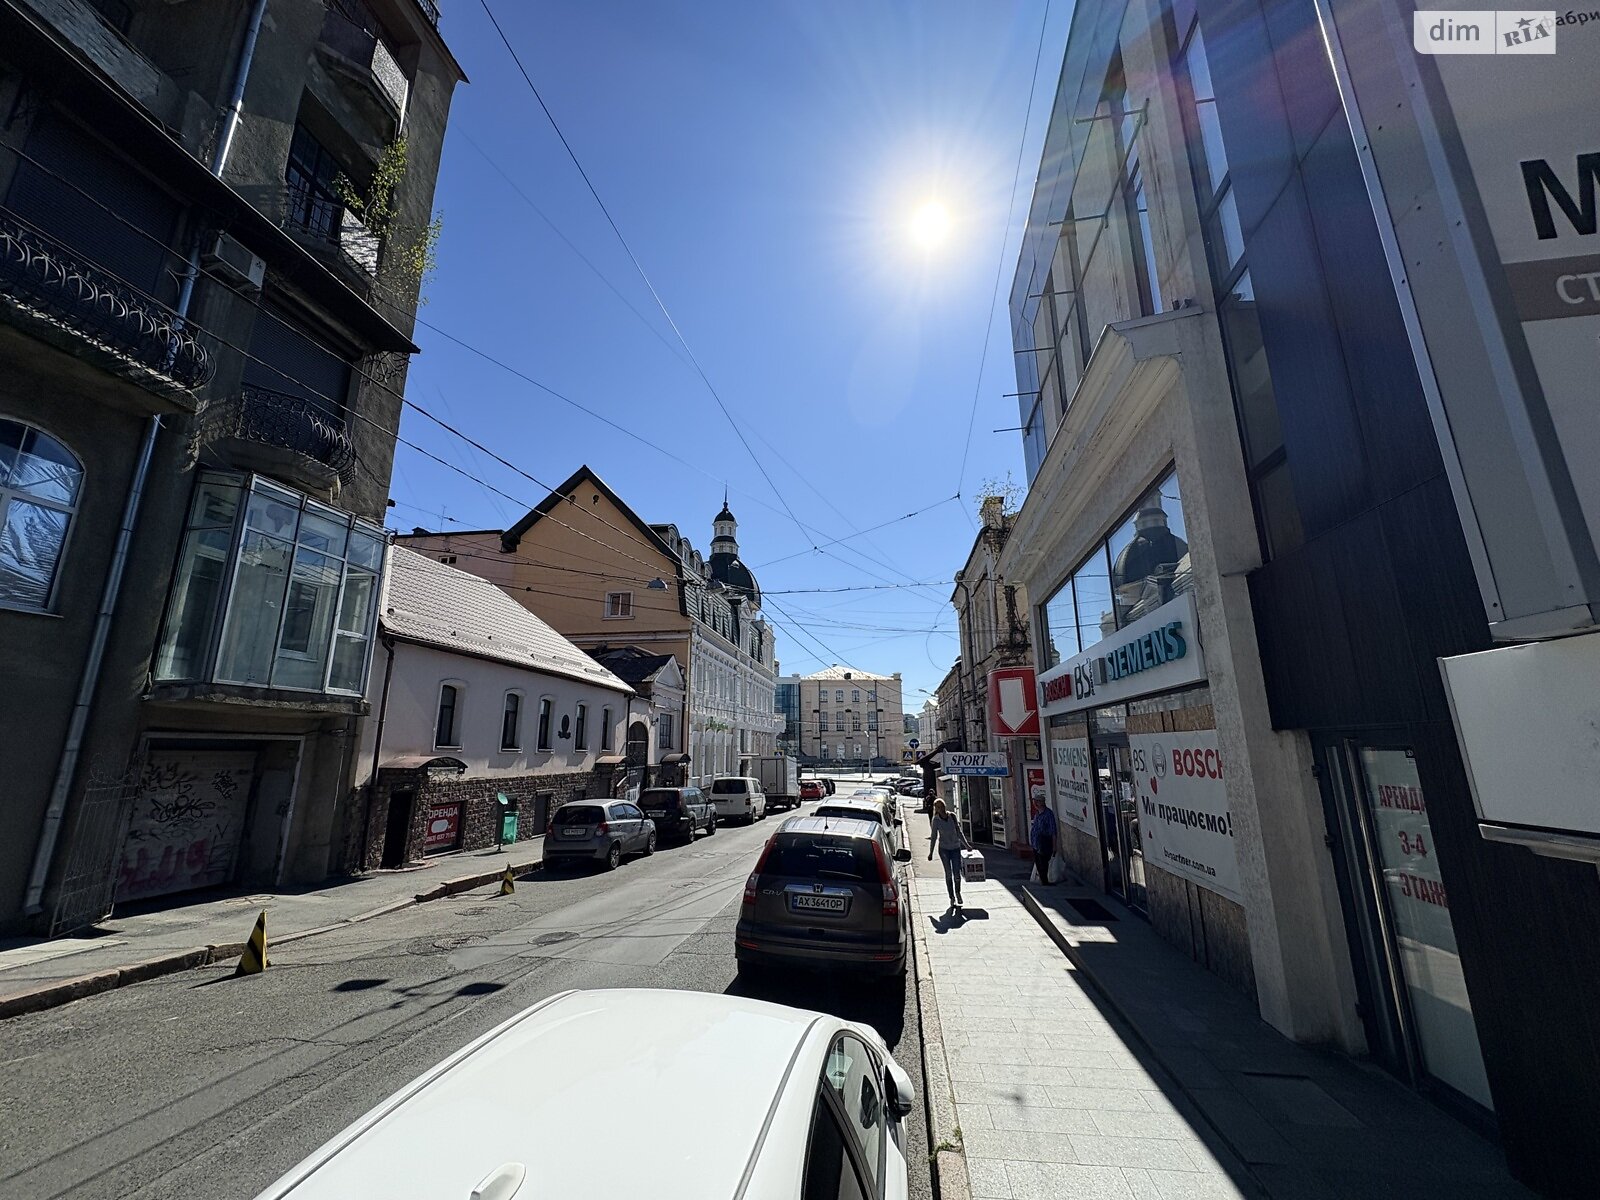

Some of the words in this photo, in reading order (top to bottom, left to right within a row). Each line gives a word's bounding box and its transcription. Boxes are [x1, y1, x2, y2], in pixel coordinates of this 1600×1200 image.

[1106, 621, 1187, 681] SIEMENS
[950, 754, 988, 766] SPORT
[1158, 803, 1234, 837] працюємо!
[1398, 830, 1428, 858] 3-4
